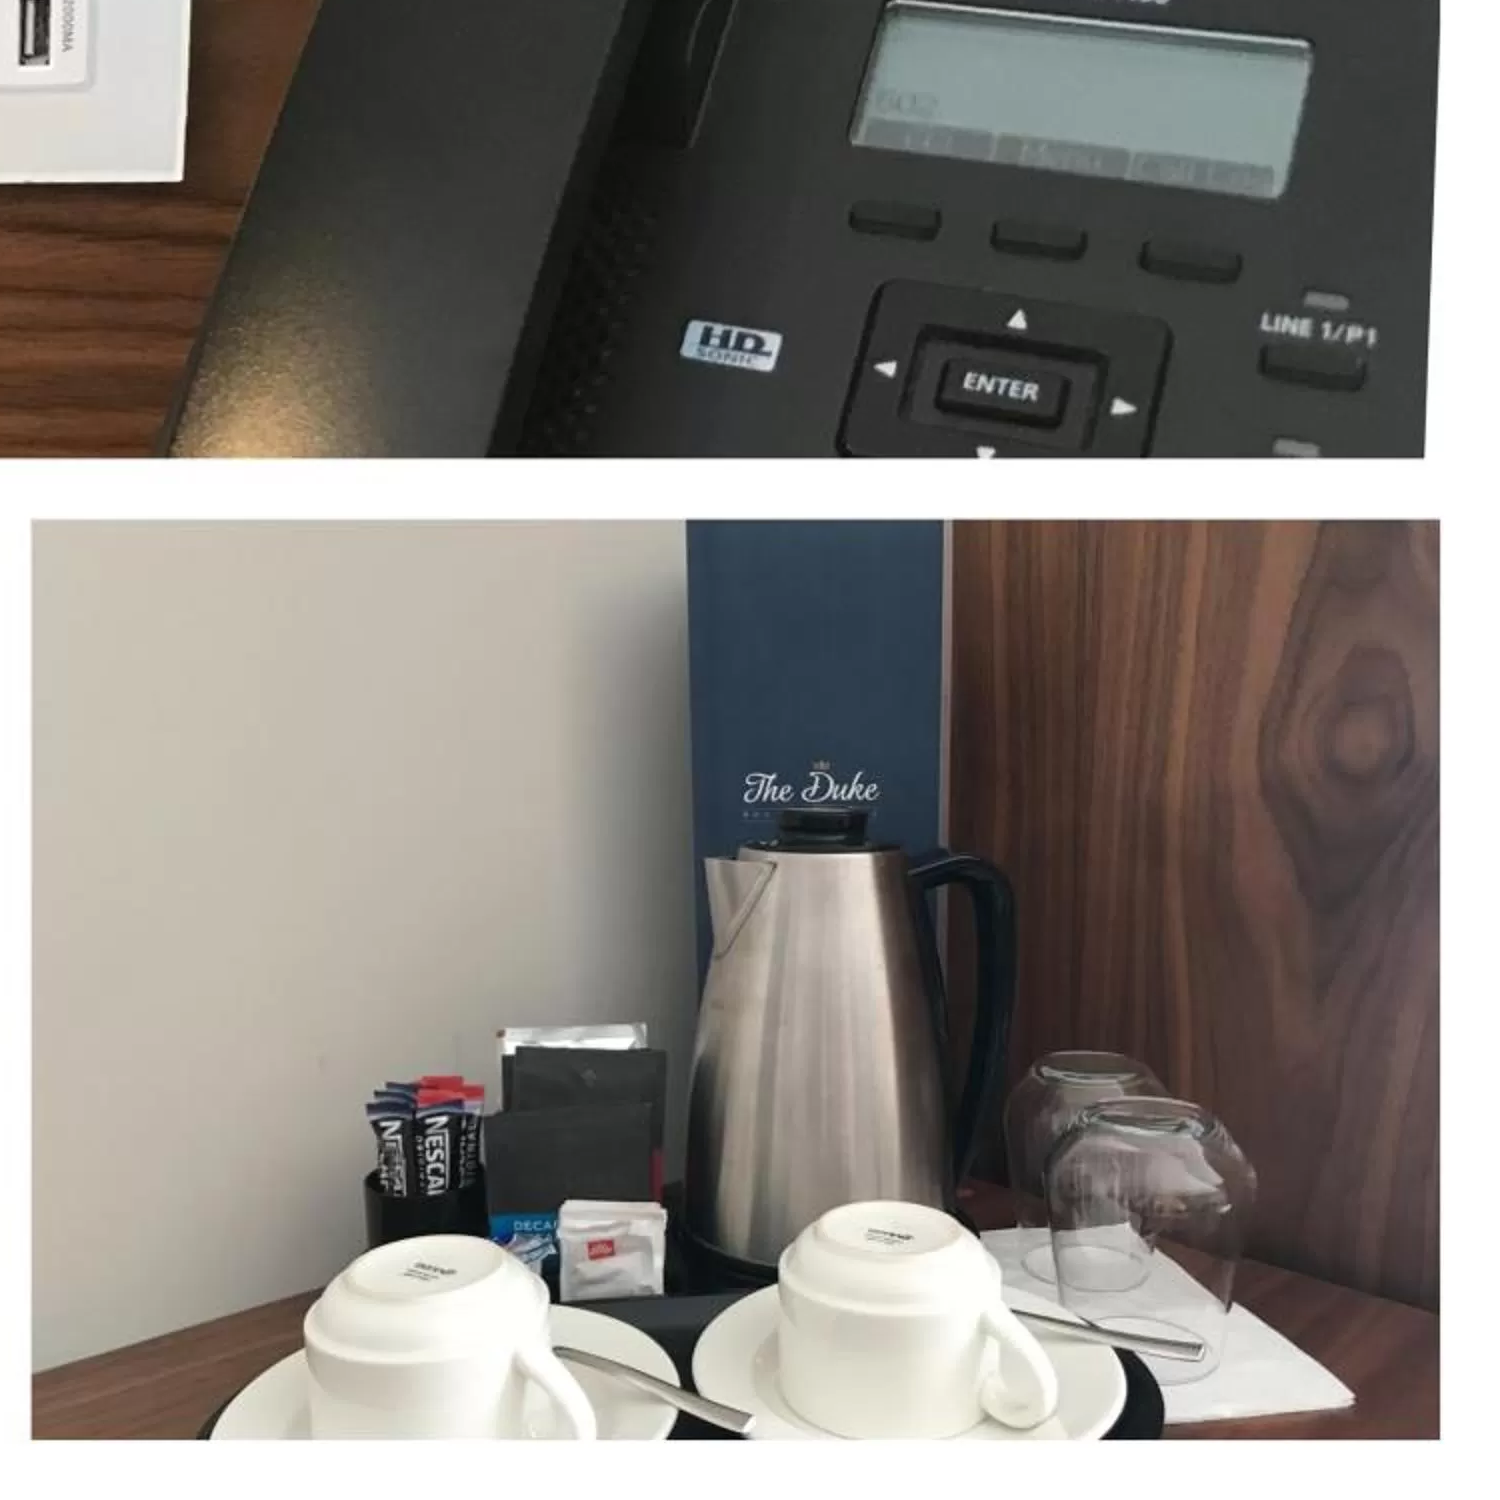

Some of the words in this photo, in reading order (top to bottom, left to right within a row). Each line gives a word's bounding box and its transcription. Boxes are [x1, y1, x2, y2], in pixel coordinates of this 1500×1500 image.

[1259, 311, 1312, 339] LINE
[962, 371, 1039, 402] ENTER
[743, 771, 796, 804] The
[800, 770, 881, 803] Duke
